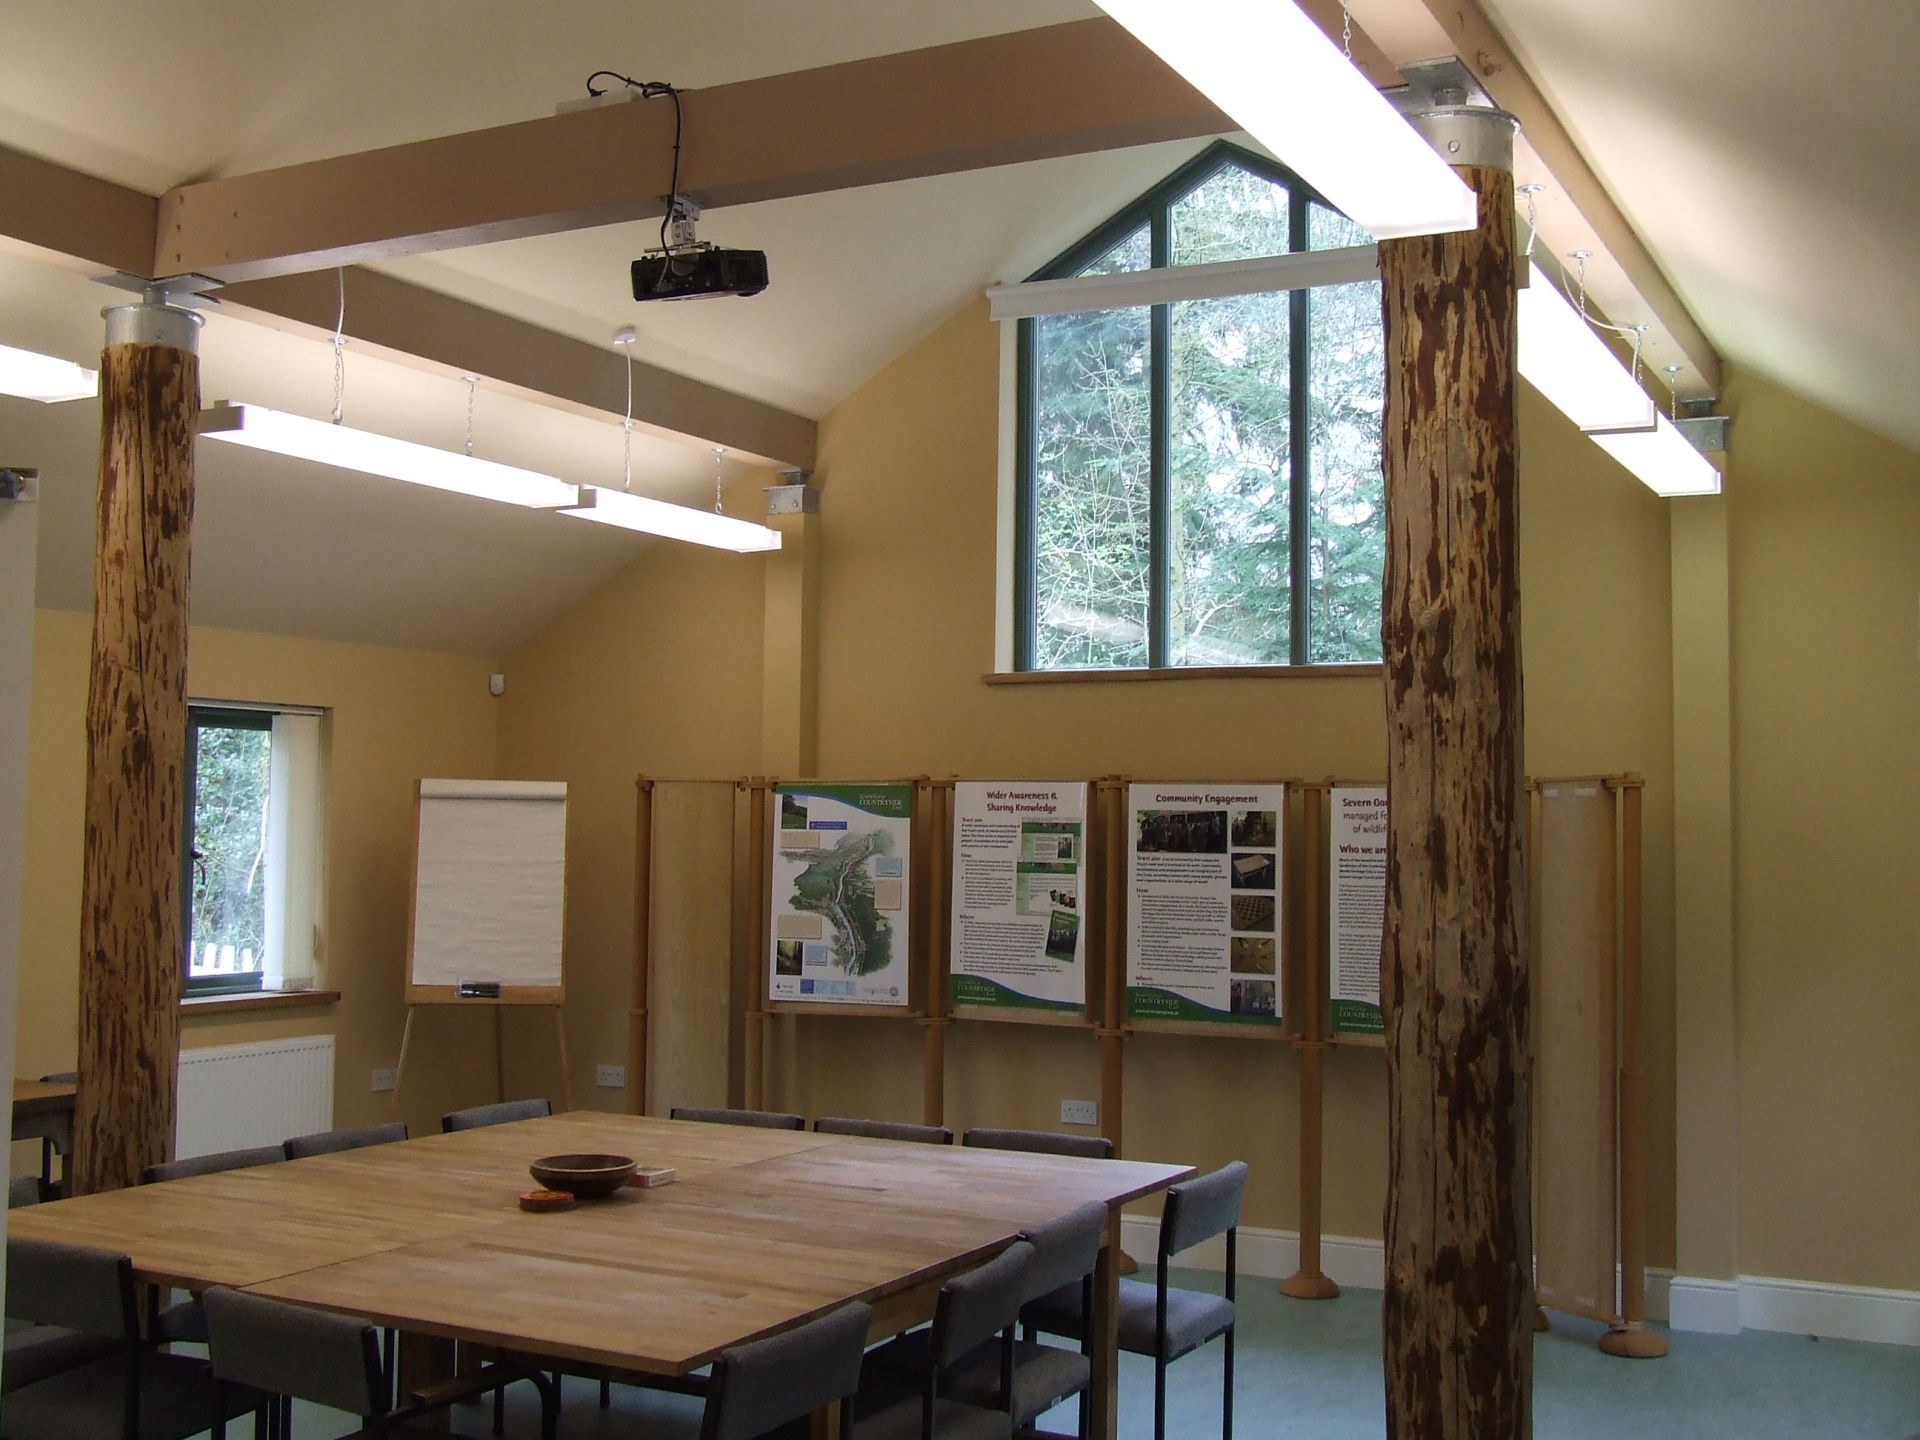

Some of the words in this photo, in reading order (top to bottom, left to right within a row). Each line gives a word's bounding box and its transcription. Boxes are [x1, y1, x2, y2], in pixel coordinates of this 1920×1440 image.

[986, 790, 1007, 800] Wider
[1009, 791, 1049, 800] Awareness
[1050, 791, 1058, 800] &
[1155, 793, 1204, 805] Community
[1205, 794, 1259, 805] Engagement
[1342, 798, 1371, 807] Severn
[1373, 798, 1387, 807] Gor
[986, 803, 1014, 814] Sharing
[1015, 803, 1057, 814] Knowledge
[1343, 811, 1378, 823] managed
[1353, 823, 1362, 833] of
[1363, 824, 1387, 833] wildlif
[1339, 844, 1359, 854] Who
